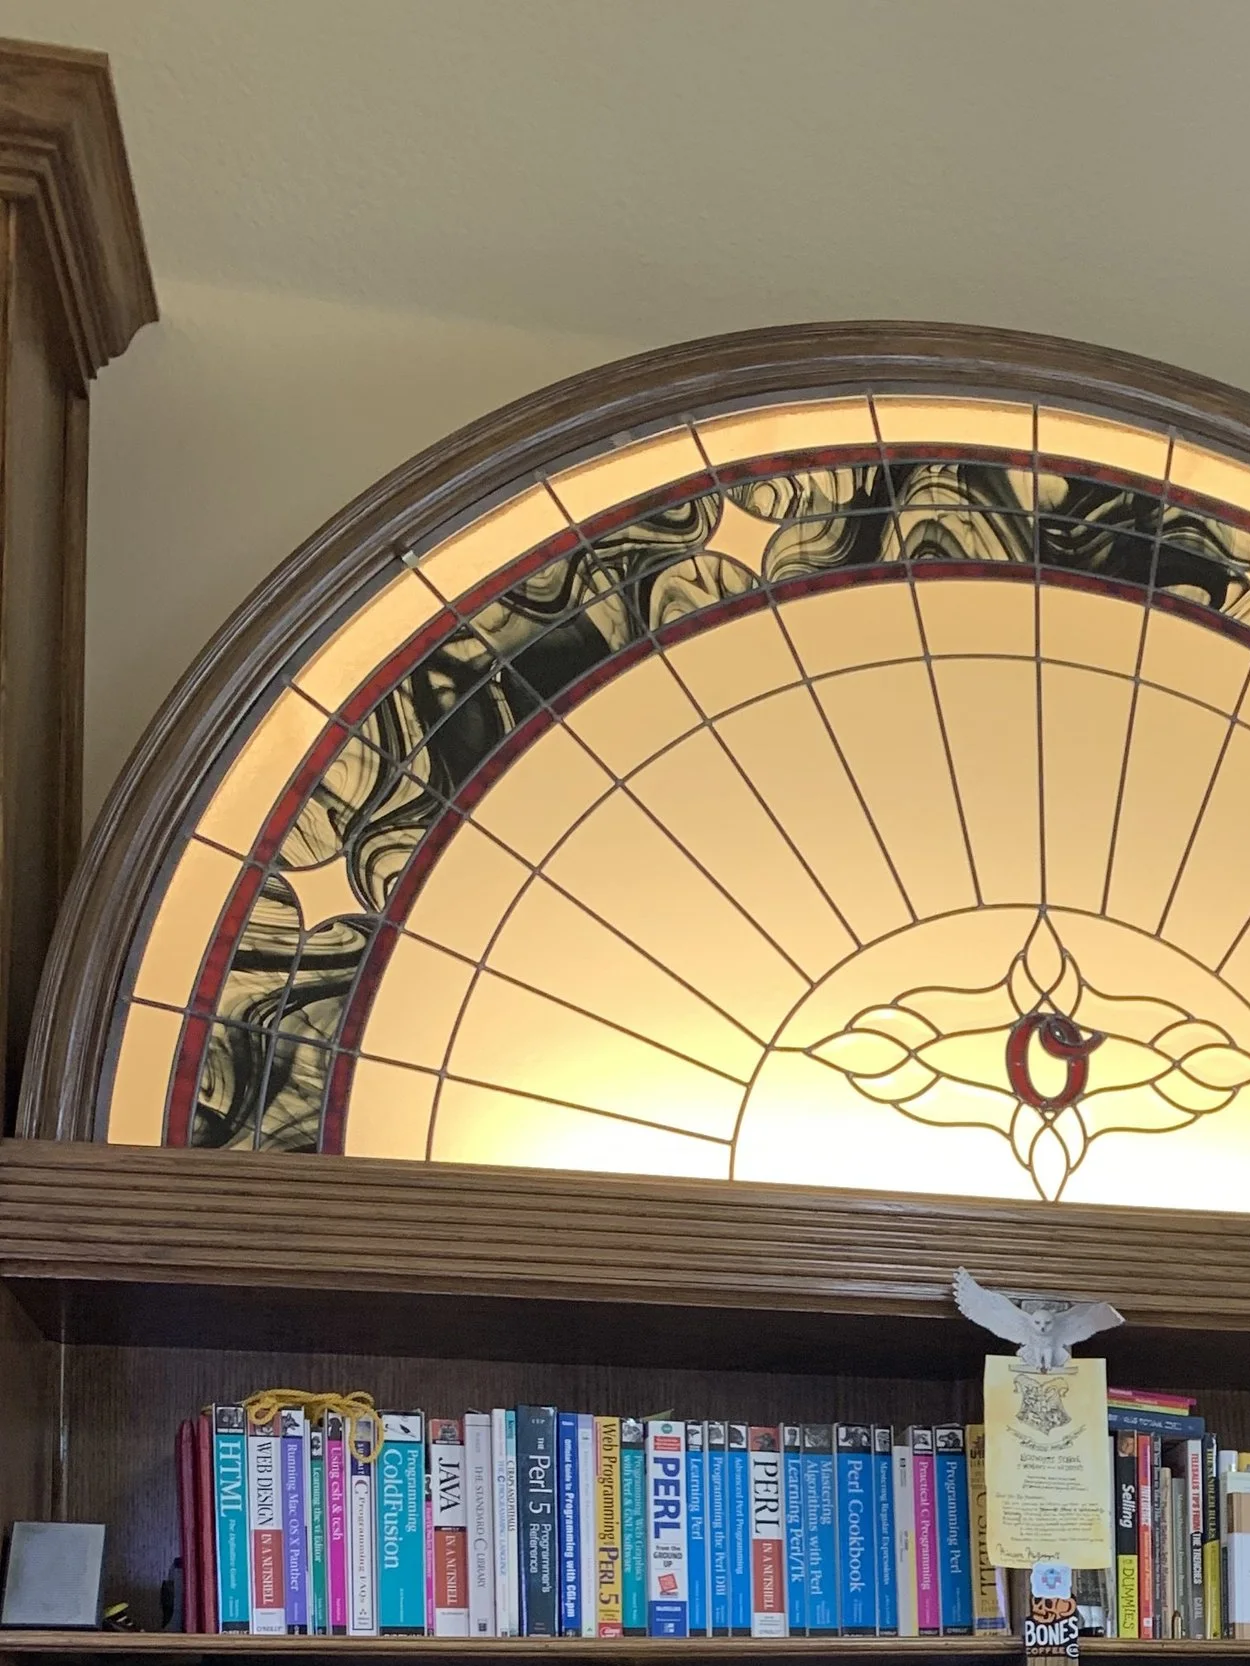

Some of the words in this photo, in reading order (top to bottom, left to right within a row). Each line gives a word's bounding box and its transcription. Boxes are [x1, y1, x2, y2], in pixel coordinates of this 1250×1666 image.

[601, 1423, 617, 1451] Web
[256, 1442, 272, 1473] WEB
[286, 1444, 300, 1490] Running
[329, 1447, 341, 1478] Using
[474, 1466, 484, 1483] THE
[528, 1455, 553, 1493] Perl
[847, 1459, 863, 1493] Perl
[1191, 1453, 1200, 1490] TELESALES
[219, 1441, 242, 1517] HTML
[332, 1482, 342, 1500] csh
[405, 1450, 419, 1532] Programming
[438, 1457, 461, 1513] JAVA
[689, 1457, 703, 1511] Learning
[735, 1457, 744, 1498] Advanced
[787, 1459, 802, 1523] Learning
[805, 1460, 820, 1532] Algorithms
[820, 1460, 833, 1525] Mastering
[918, 1461, 930, 1507] Practical
[256, 1477, 274, 1526] DESIGN
[288, 1493, 299, 1516] Mac
[332, 1504, 342, 1513] &
[383, 1448, 403, 1569] ColdFusion
[475, 1485, 485, 1535] STANDARD
[528, 1501, 551, 1514] 5
[598, 1455, 620, 1540] Programming
[653, 1456, 681, 1539] PERL
[735, 1500, 744, 1517] Perl
[753, 1460, 779, 1534] PERL
[920, 1509, 930, 1517] C
[945, 1461, 959, 1546] Programming
[1120, 1484, 1135, 1528] Selling
[1191, 1492, 1201, 1509] TIPS
[261, 1533, 272, 1544] IN
[289, 1519, 299, 1534] OS
[332, 1517, 343, 1540] tcsh
[691, 1516, 703, 1540] Perl
[1191, 1510, 1201, 1532] FROM
[289, 1536, 299, 1545] X
[474, 1538, 488, 1551] C
[529, 1523, 540, 1573] Reference
[539, 1523, 552, 1593] Programmer's
[735, 1519, 745, 1574] Programming
[789, 1528, 803, 1582] Perl/Tk
[810, 1535, 822, 1565] with
[849, 1499, 865, 1592] Cookbook
[919, 1520, 933, 1590] Programming
[1191, 1533, 1201, 1547] THE
[289, 1549, 301, 1592] Panther
[477, 1553, 487, 1588] LIBRARY
[599, 1546, 619, 1589] PERL
[949, 1549, 961, 1573] Perl
[1192, 1548, 1202, 1584] TRENCHES
[262, 1558, 274, 1605] NUTSHELL
[601, 1593, 619, 1604] 5
[811, 1570, 823, 1595] Perl
[1122, 1568, 1135, 1630] DUMMIES
[1025, 1617, 1079, 1646] BONES
[1026, 1646, 1065, 1655] COFFEE
